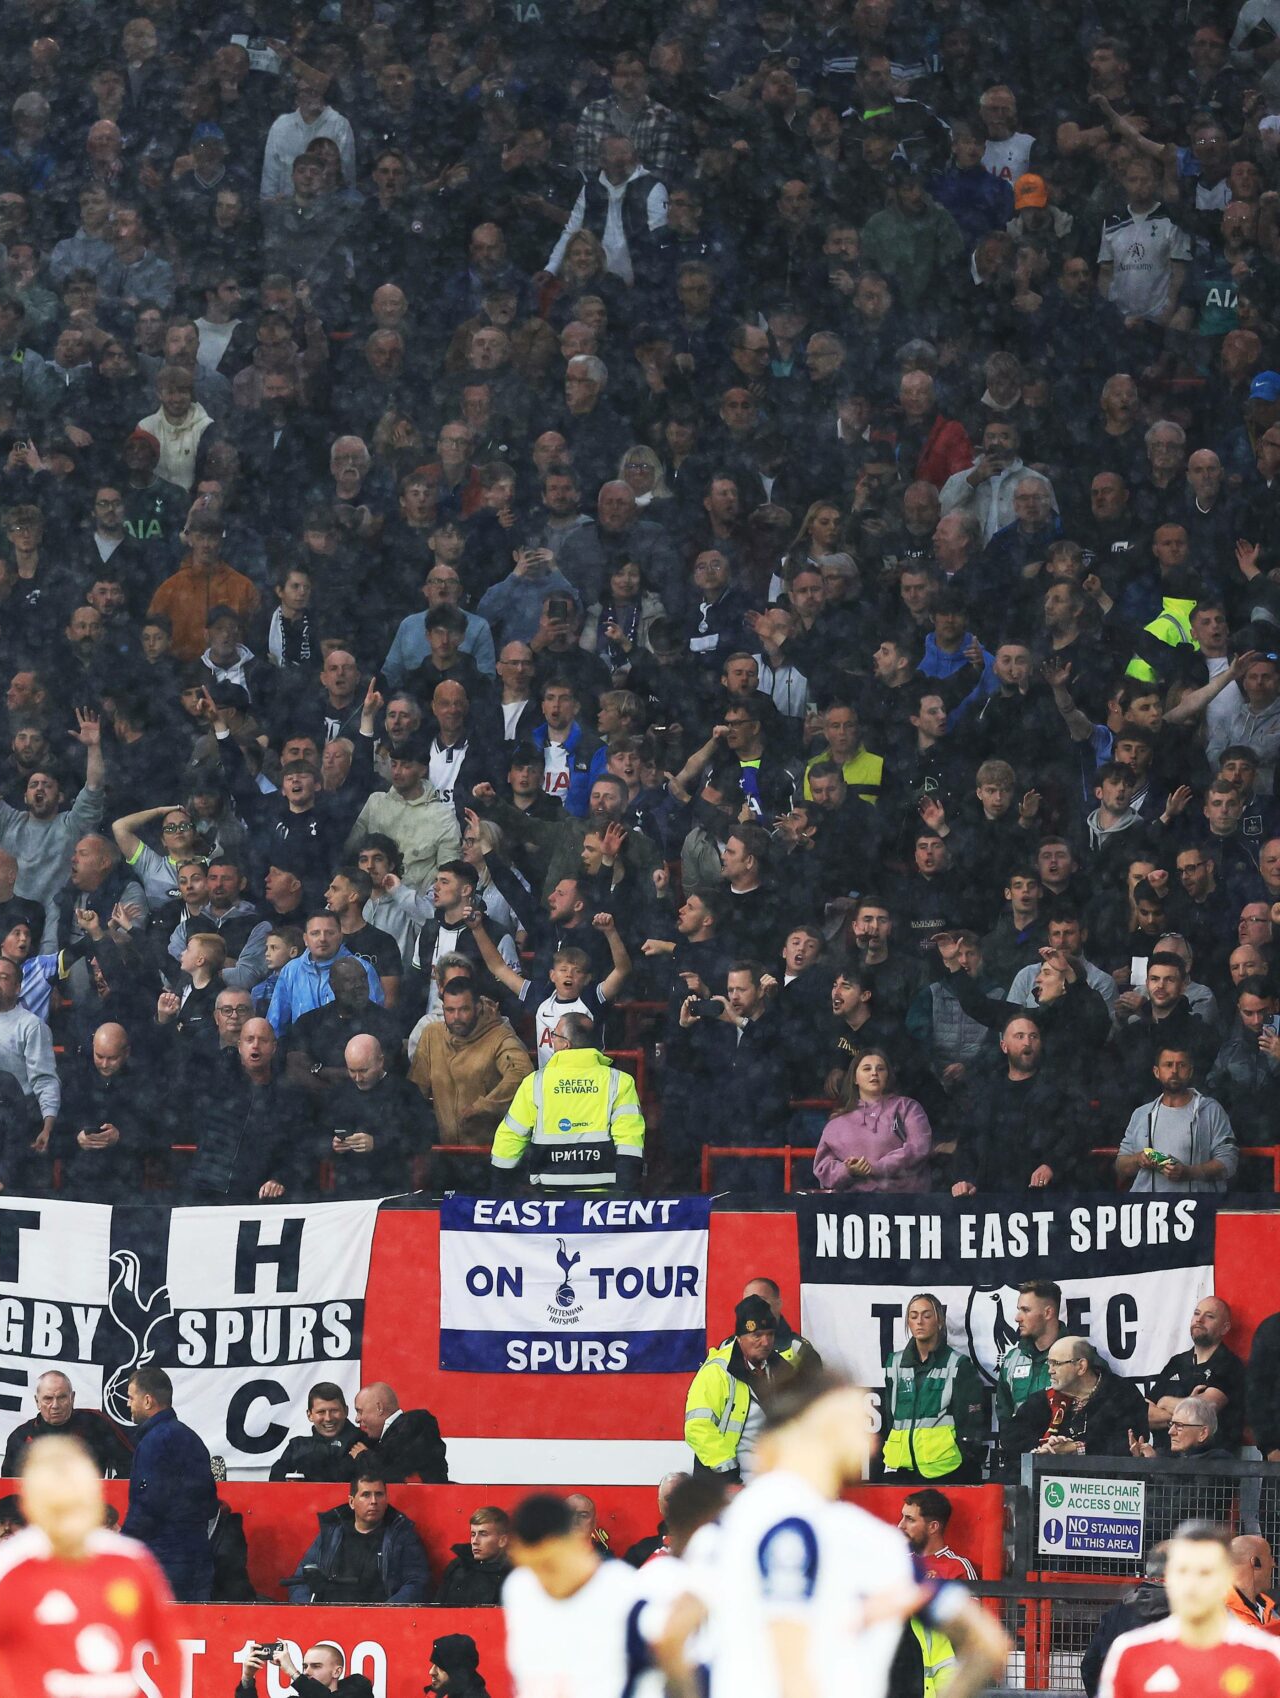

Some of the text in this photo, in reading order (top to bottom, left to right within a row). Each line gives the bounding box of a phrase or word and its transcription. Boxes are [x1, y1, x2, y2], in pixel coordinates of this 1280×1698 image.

[554, 1086, 599, 1094] STEWARD
[473, 1199, 680, 1226] EAST KENT
[816, 1199, 1198, 1260] NORTH EAST SPURS
[234, 1218, 306, 1294] H
[465, 1265, 699, 1300] ON TOUR
[546, 1304, 584, 1317] TOTTENHAM
[548, 1315, 580, 1326] HOTSPUR
[177, 1301, 352, 1367] SPURS
[506, 1339, 629, 1372] SPURS
[226, 1379, 291, 1455] C
[1070, 1483, 1140, 1498] WHEELCHAIR
[1067, 1498, 1141, 1513] ACCESS ONLY
[1068, 1518, 1139, 1536] NO STANDING
[1072, 1537, 1134, 1550] IN THIS AREA
